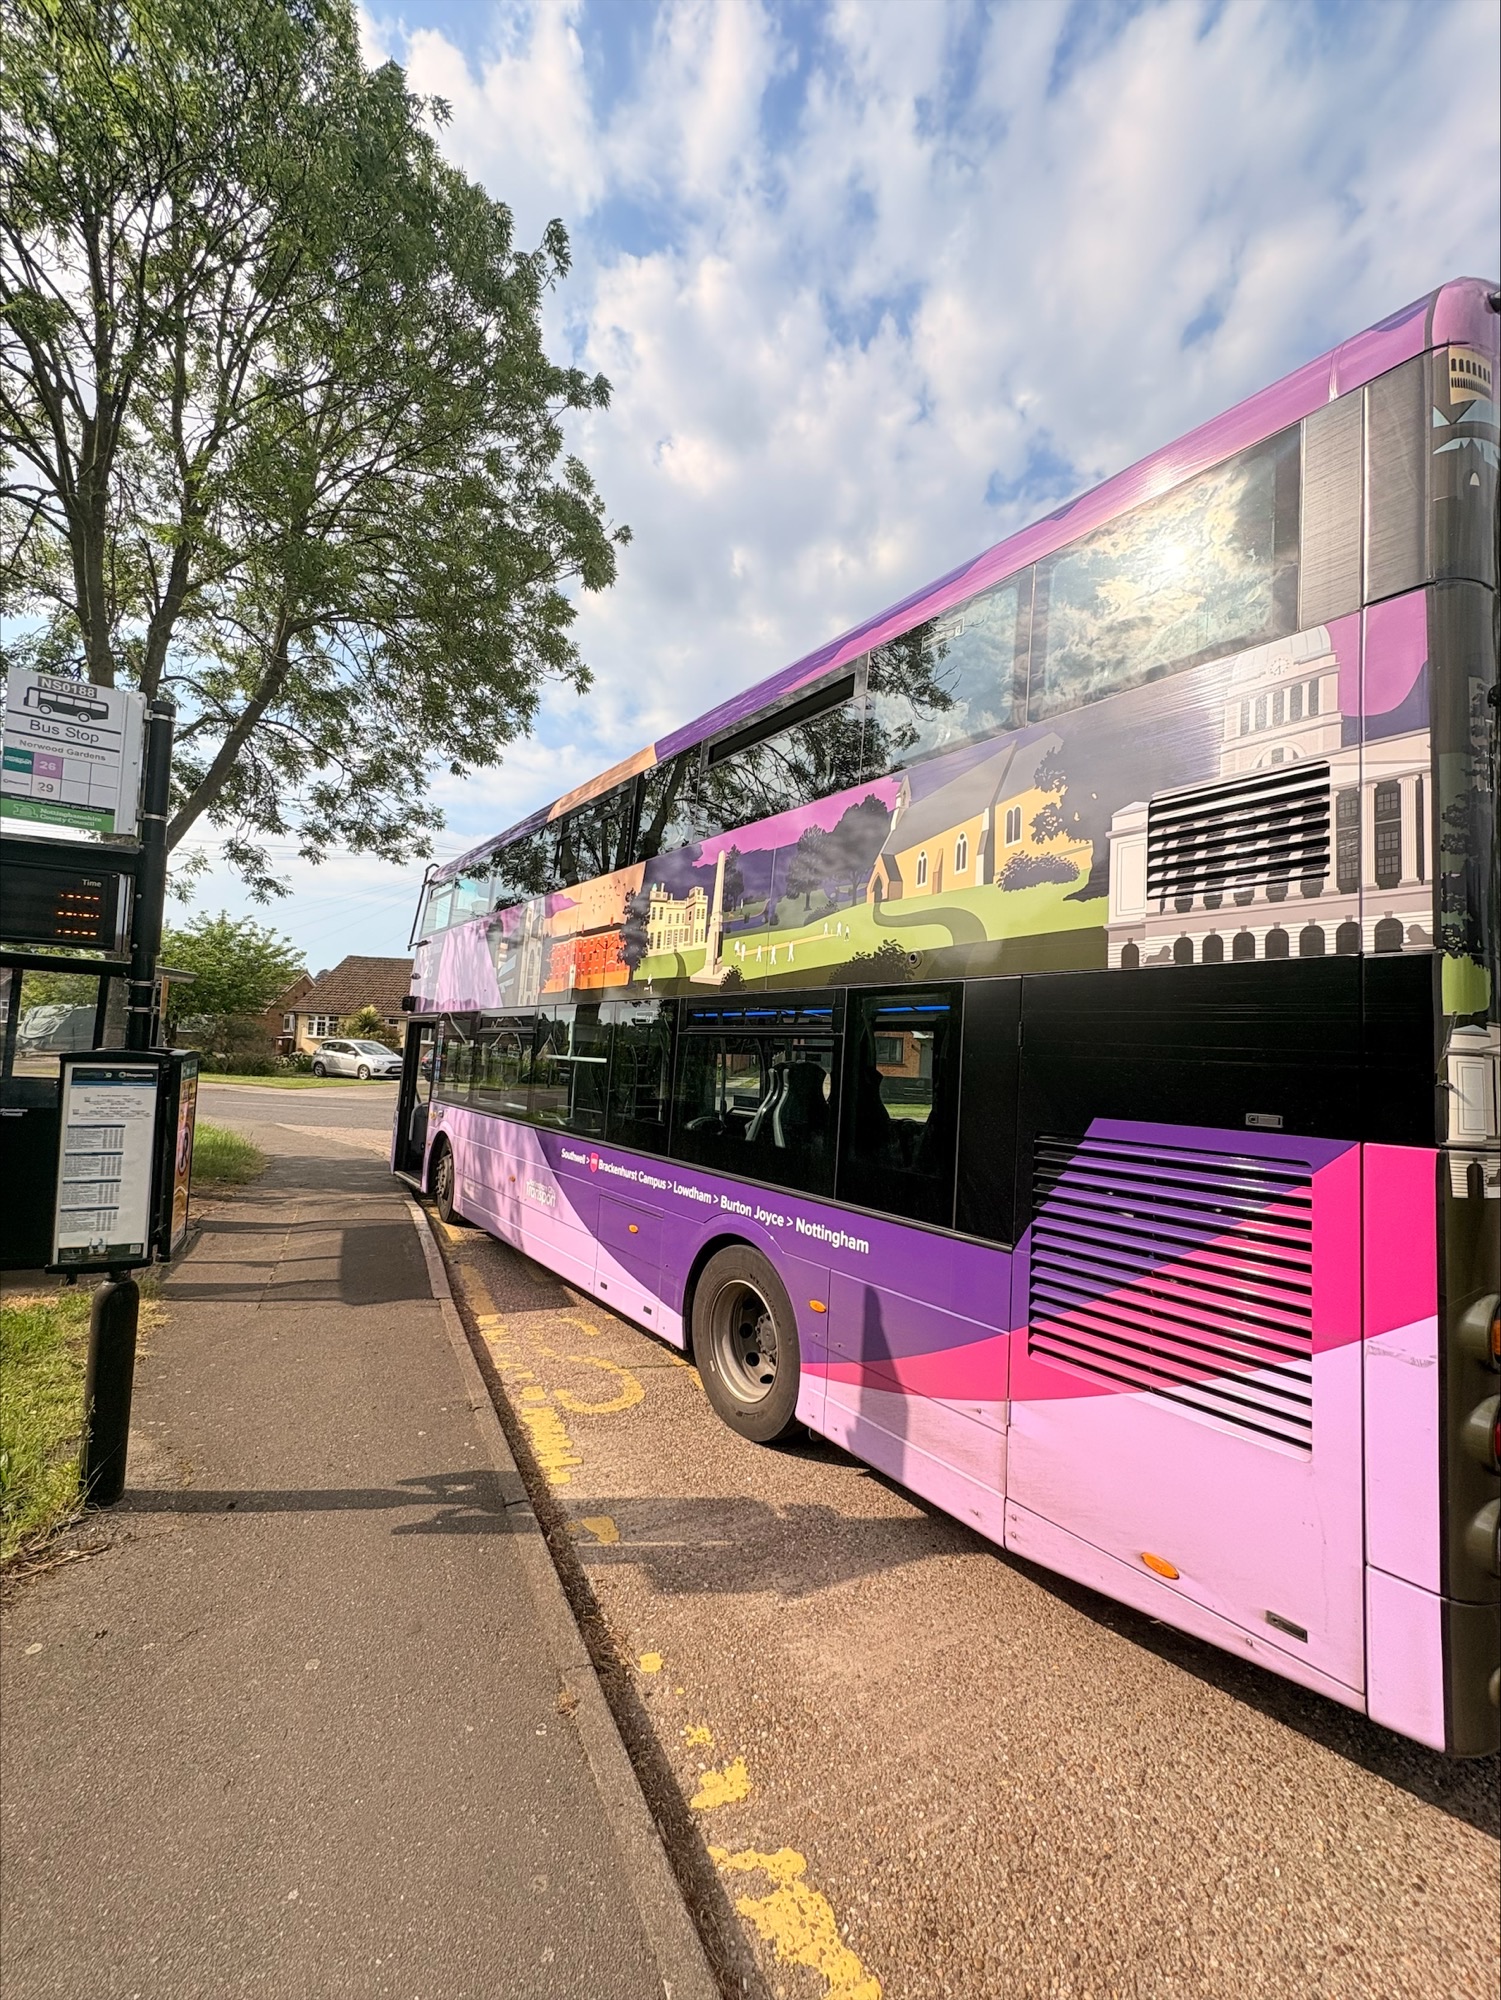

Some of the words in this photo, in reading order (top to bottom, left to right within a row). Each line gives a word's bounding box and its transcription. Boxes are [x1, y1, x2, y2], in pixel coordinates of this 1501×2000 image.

[41, 678, 96, 698] NS0188
[29, 719, 60, 735] Bus
[65, 727, 99, 743] Stop
[19, 739, 64, 753] Norwood
[66, 748, 106, 761] Gardens
[39, 761, 56, 771] 26
[38, 782, 54, 793] 29
[82, 879, 102, 887] Time
[561, 1148, 586, 1165] Southwell
[598, 1159, 638, 1181] Brackenhurst
[638, 1172, 666, 1189] Campus
[673, 1181, 712, 1204] Lowdham
[720, 1195, 752, 1217] Burton
[754, 1206, 784, 1226] Joyce
[795, 1219, 868, 1254] Nottingham
